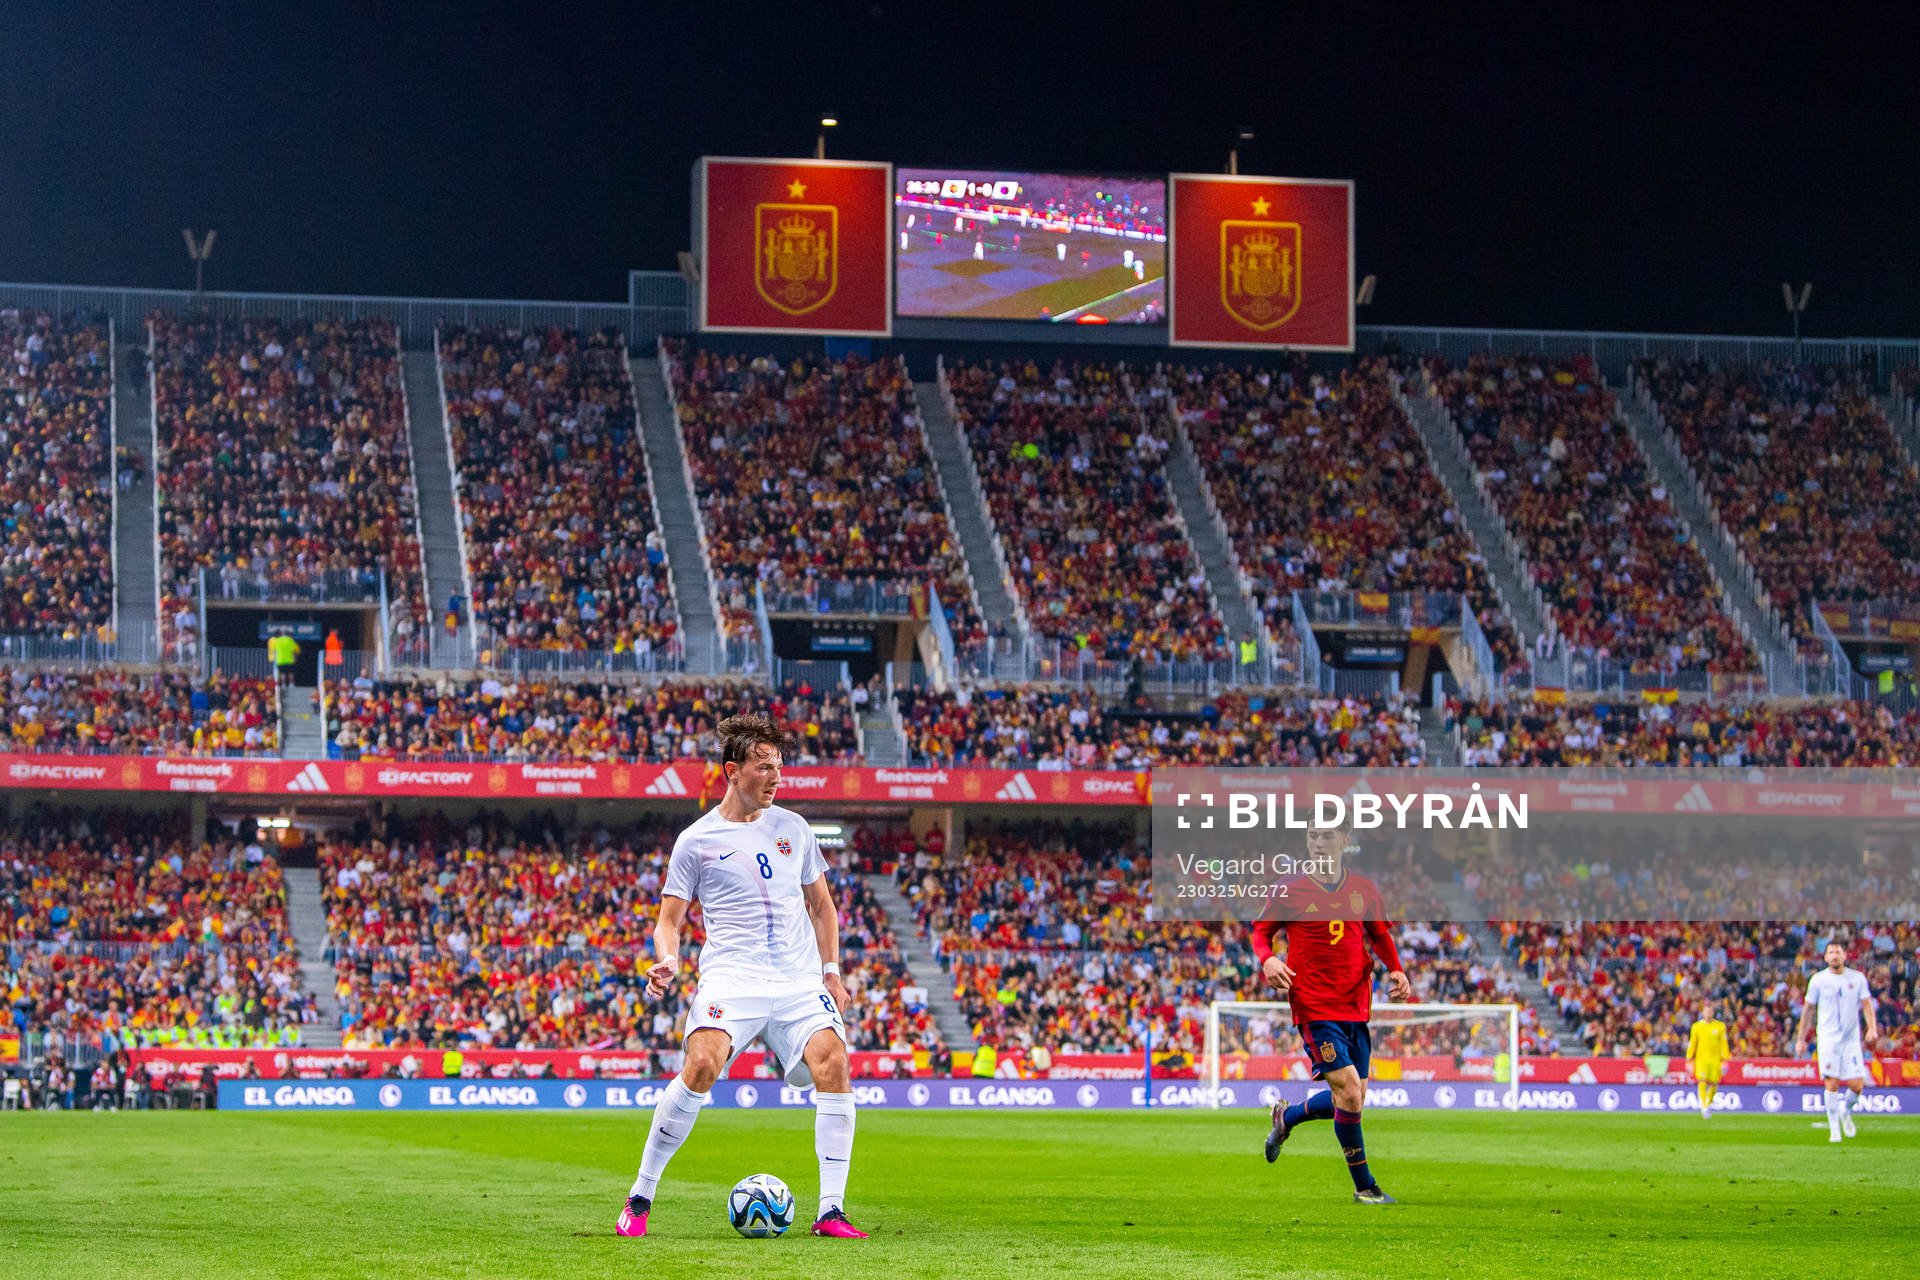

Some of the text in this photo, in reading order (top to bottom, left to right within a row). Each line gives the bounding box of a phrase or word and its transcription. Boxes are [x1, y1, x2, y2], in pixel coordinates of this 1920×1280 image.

[756, 852, 773, 880] 8
[1328, 919, 1345, 946] 9
[818, 994, 836, 1014] 8
[244, 1085, 355, 1106] EL GANSO
[429, 1085, 538, 1106] EL GANSO
[606, 1087, 632, 1107] EL
[780, 1086, 807, 1106] EL
[949, 1085, 1055, 1106] EL GANSO
[1474, 1088, 1500, 1108] EL
[1640, 1090, 1667, 1110] EL
[1801, 1093, 1825, 1112] EL
